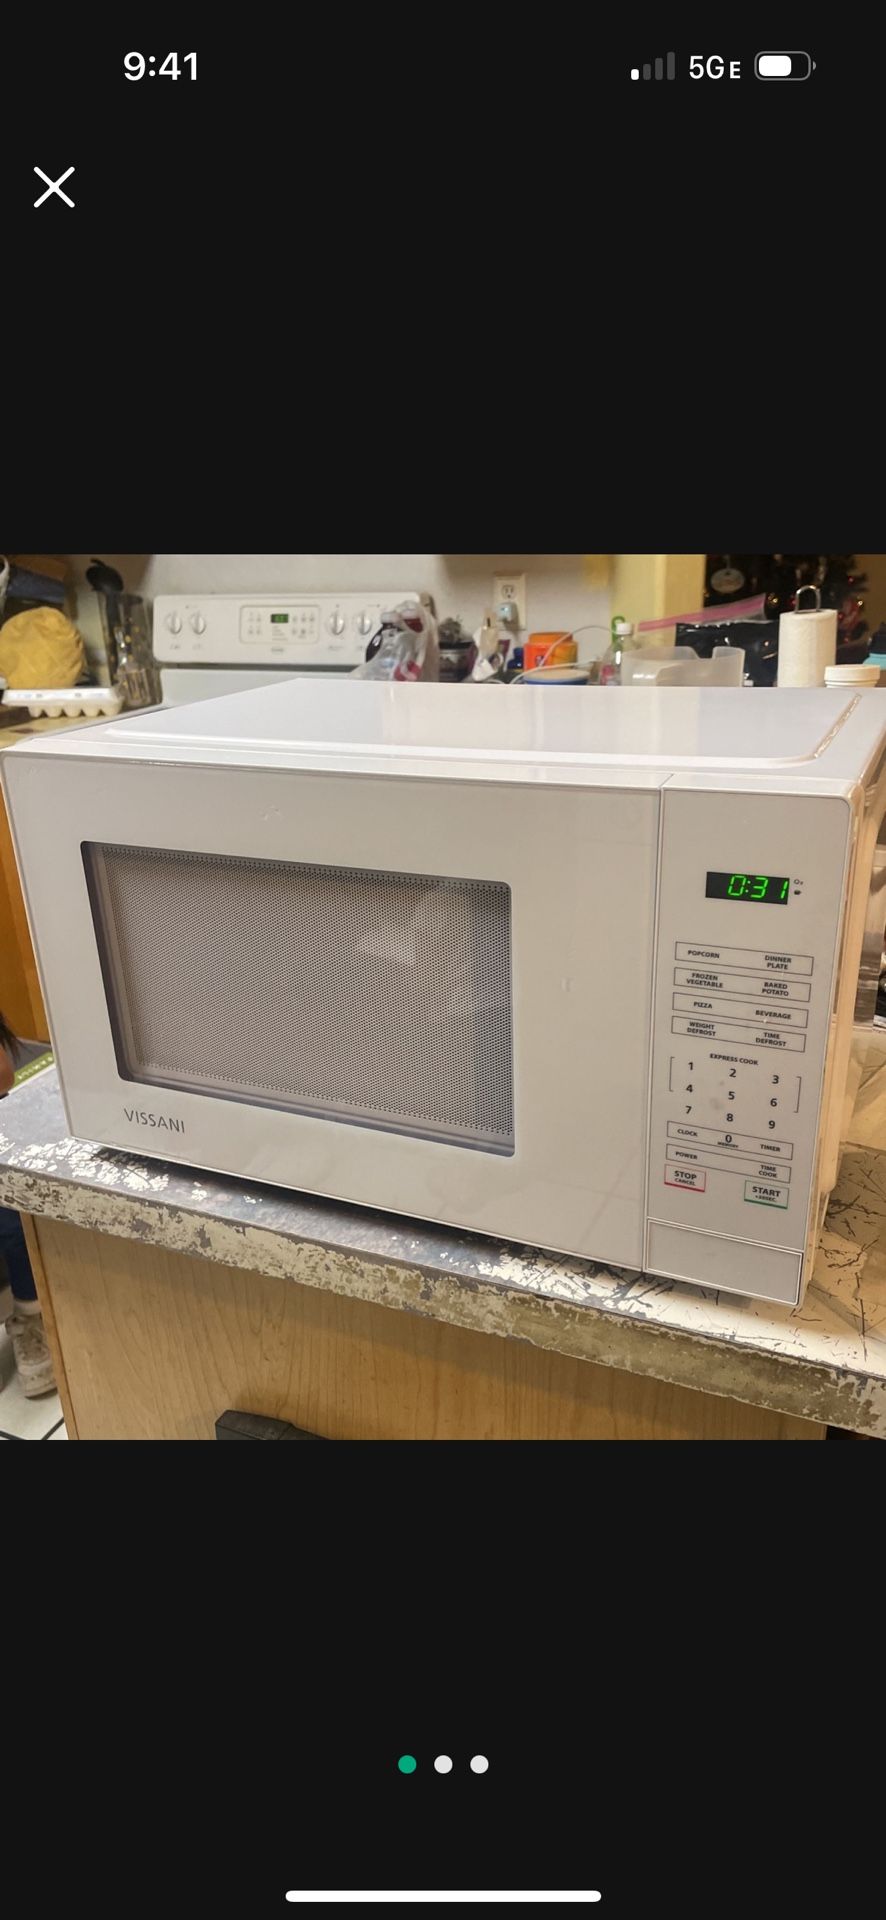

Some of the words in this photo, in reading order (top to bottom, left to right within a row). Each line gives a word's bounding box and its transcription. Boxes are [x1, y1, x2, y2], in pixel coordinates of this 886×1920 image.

[728, 875, 789, 899] 0:31
[688, 950, 720, 959] POPCORN
[764, 955, 792, 963] DINNER
[766, 962, 788, 970] PLATE
[692, 973, 718, 981] FROZEN
[686, 978, 723, 988] VEGETABLE
[764, 982, 787, 990] BAKED
[762, 988, 789, 996] POTATO
[693, 1001, 713, 1009] PIZZA
[755, 1010, 792, 1020] BEVERAGE
[689, 1021, 715, 1030] WEIGHT
[687, 1027, 716, 1037] DEFROST
[755, 1037, 787, 1047] DEFROST
[709, 1053, 738, 1063] EXPRESS
[739, 1057, 759, 1066] COOK
[688, 1062, 694, 1071] 1
[729, 1068, 737, 1078] 2
[771, 1075, 779, 1085] 3
[686, 1084, 693, 1093] 4
[728, 1091, 735, 1100] 5
[770, 1098, 777, 1107] 6
[685, 1105, 692, 1114] 7
[123, 1108, 185, 1133] VISSANI
[726, 1113, 734, 1122] 8
[768, 1120, 776, 1129] 9
[677, 1128, 698, 1137] CLOCK
[725, 1134, 732, 1143] 0
[760, 1144, 781, 1152] TIMER
[675, 1151, 698, 1160] POWER
[760, 1164, 776, 1172] TIME
[674, 1170, 697, 1180] STOP
[758, 1170, 778, 1178] COOK
[674, 1178, 696, 1186] CANCEL
[752, 1186, 781, 1197] START
